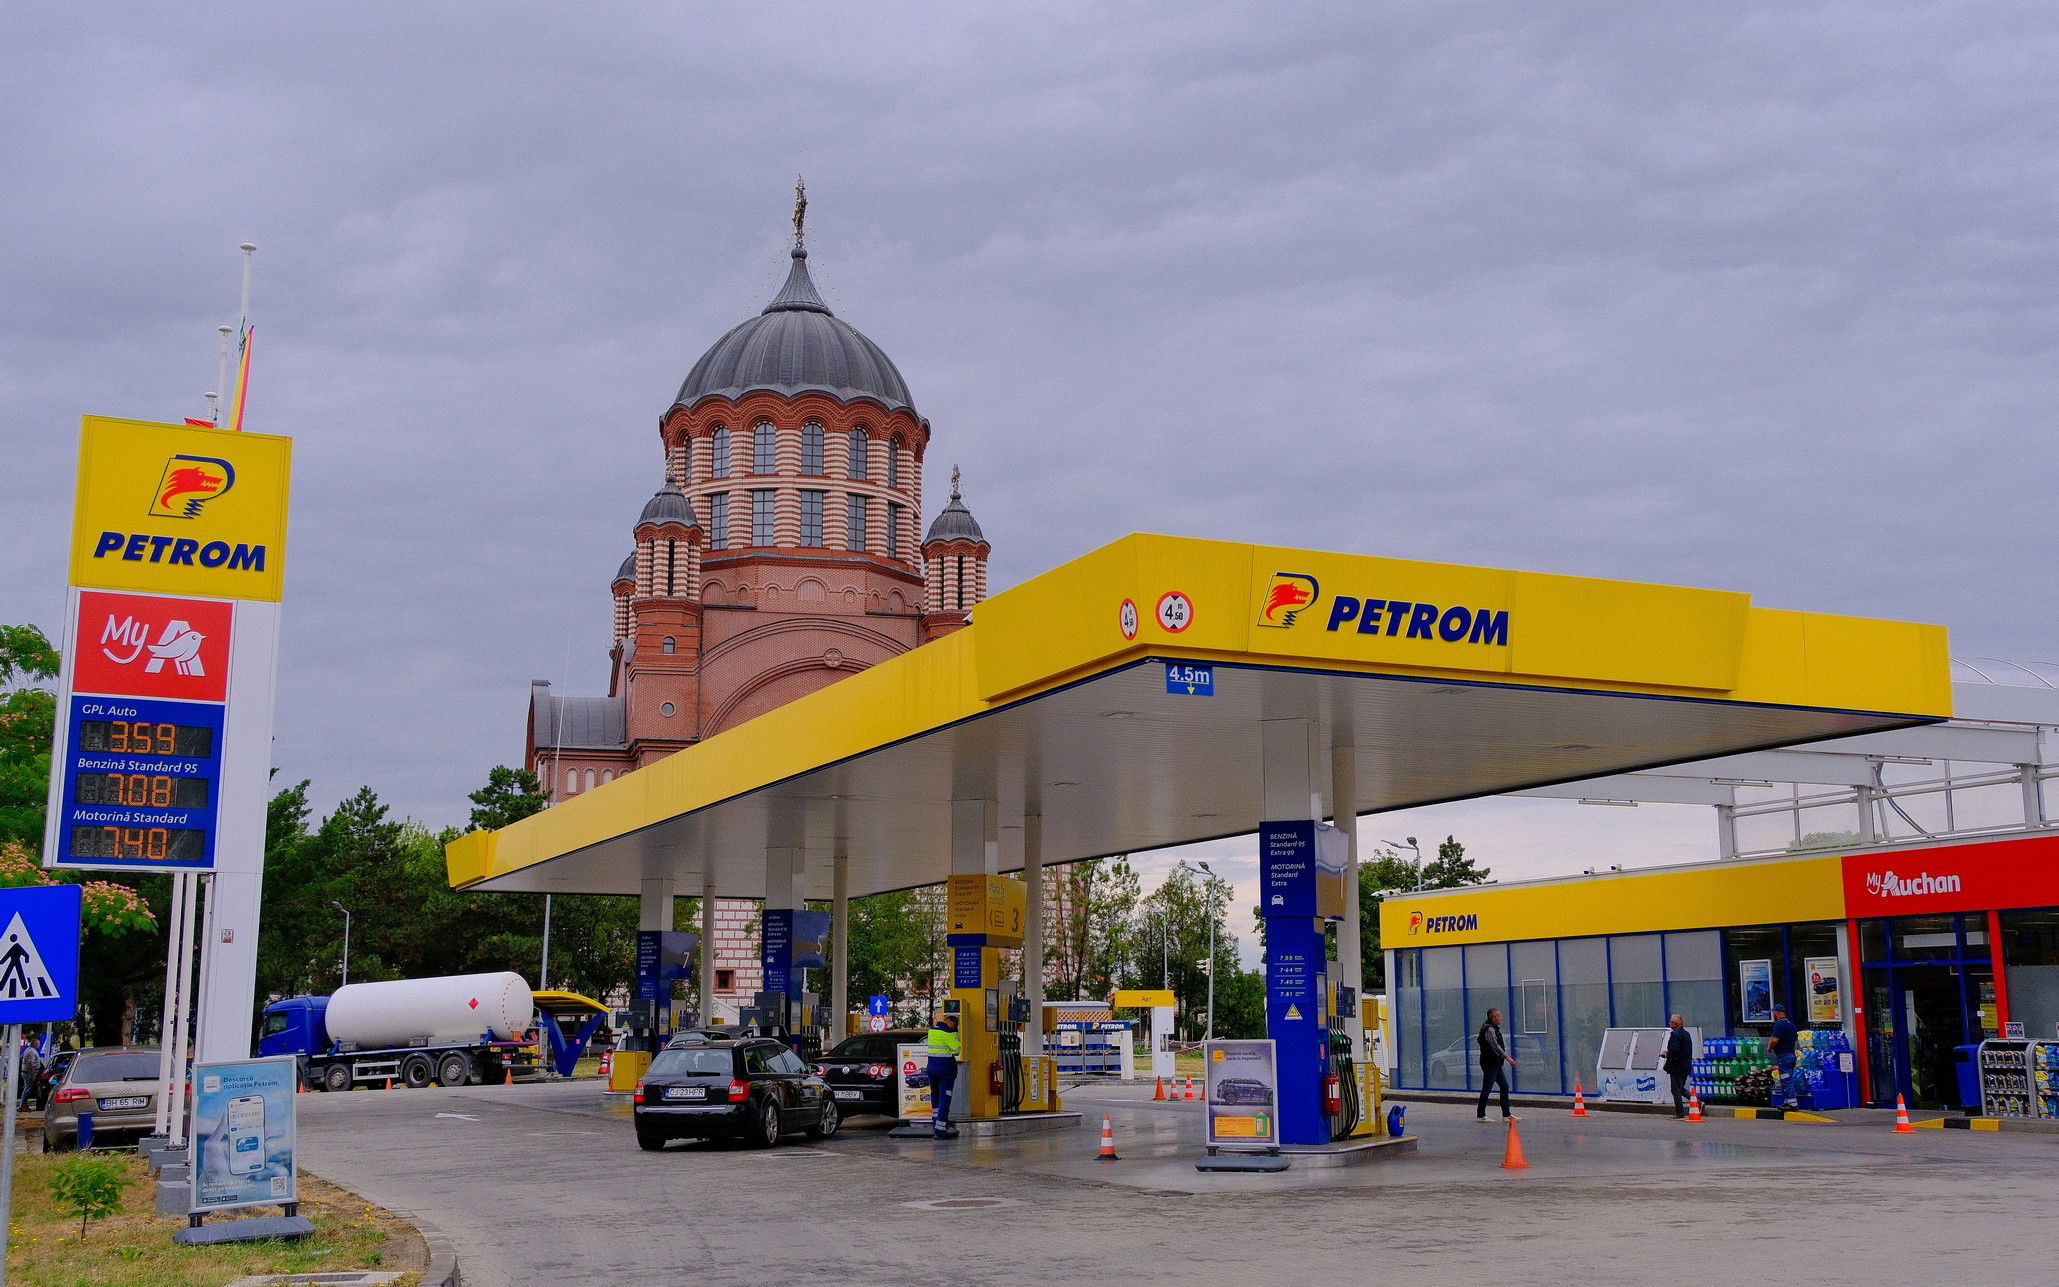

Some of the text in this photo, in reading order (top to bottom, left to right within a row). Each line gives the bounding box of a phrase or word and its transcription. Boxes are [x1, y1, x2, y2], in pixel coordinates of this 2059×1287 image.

[93, 531, 266, 572] PETROM
[1326, 595, 1509, 646] PETROM
[101, 614, 149, 664] My
[1169, 665, 1210, 683] 4.5m
[82, 704, 138, 717] GPL Auto
[110, 721, 176, 755] 3.59
[77, 758, 198, 774] Benzină Standard 95
[108, 773, 172, 808] 7.08
[73, 809, 188, 824] Motorină Standard
[103, 826, 168, 860] 7.40
[1271, 871, 1299, 879] Standard
[1866, 870, 1961, 898] My Auchan
[1011, 907, 1019, 933] 3
[1425, 914, 1478, 934] PETROM
[815, 934, 823, 956] 5
[683, 951, 690, 969] 7
[120, 1098, 129, 1106] 65
